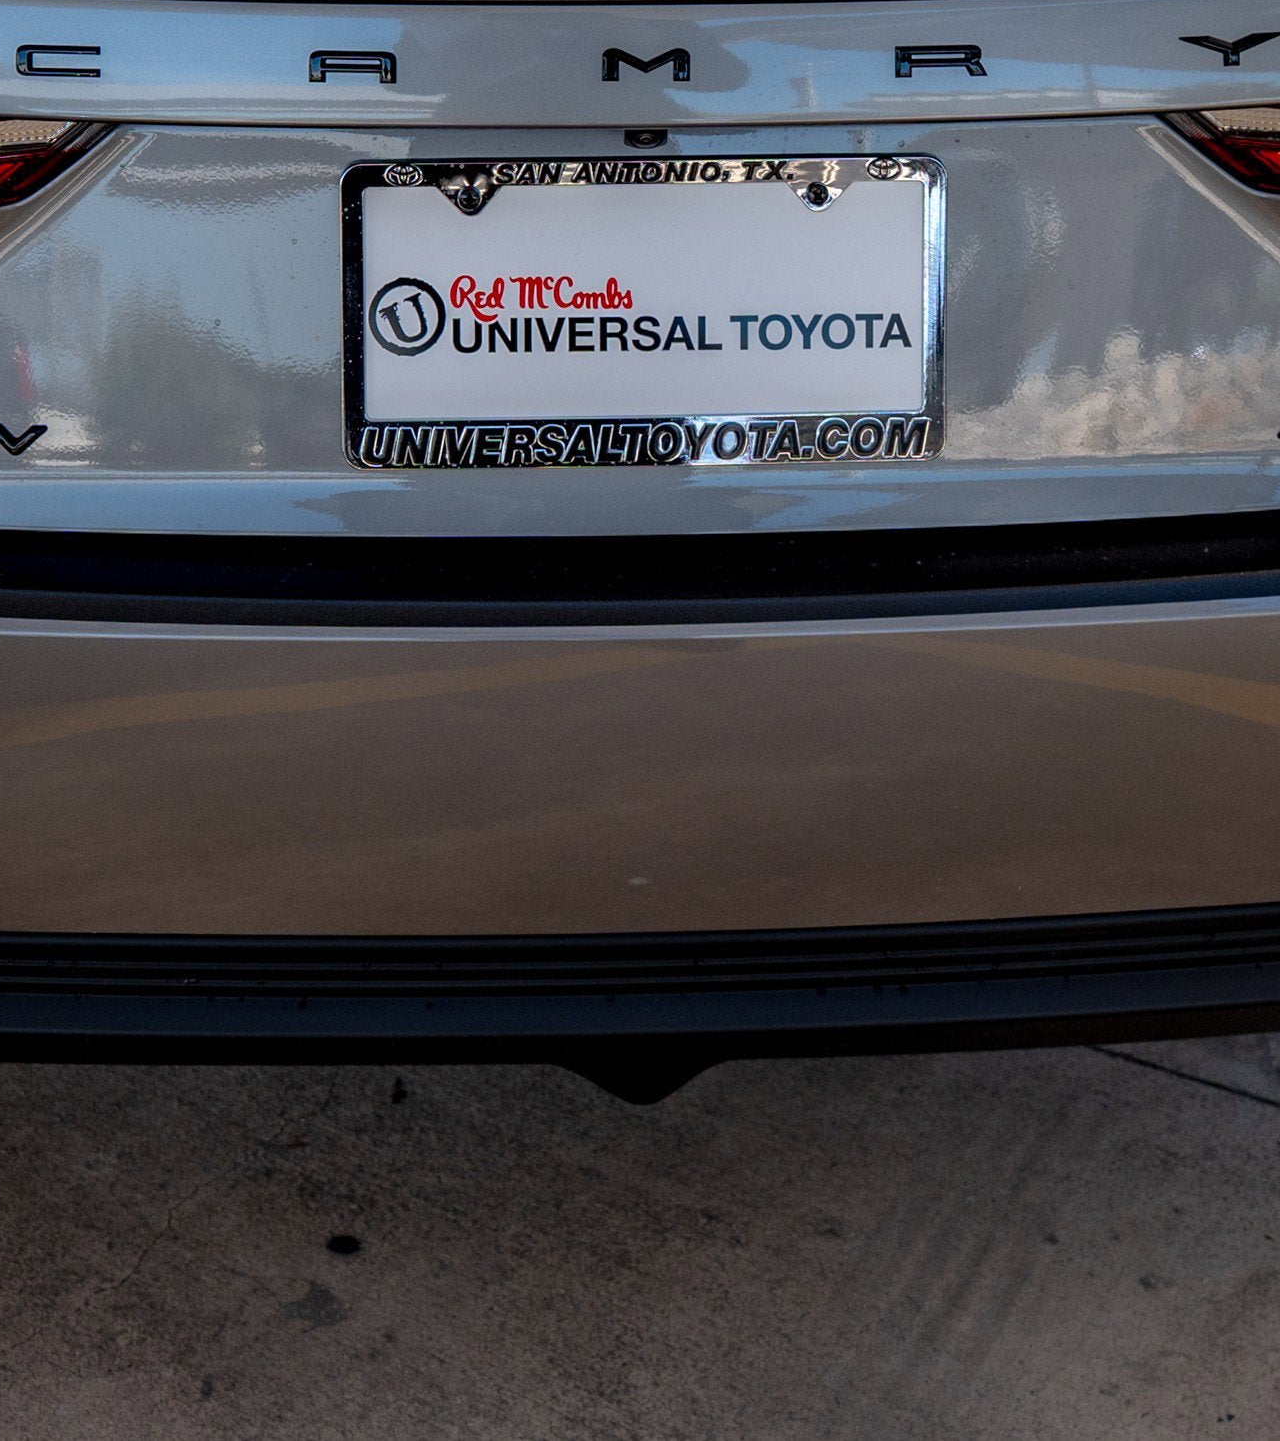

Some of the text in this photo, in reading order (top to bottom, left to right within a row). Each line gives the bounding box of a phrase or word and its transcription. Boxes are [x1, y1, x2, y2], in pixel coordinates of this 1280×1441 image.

[494, 160, 795, 185] SAN ANTONIO, TX.
[450, 275, 634, 323] Red McCombs
[452, 313, 912, 353] UNIVERSAL TOYOTA
[360, 418, 930, 466] UNIVERSALTOYOTA.COM
